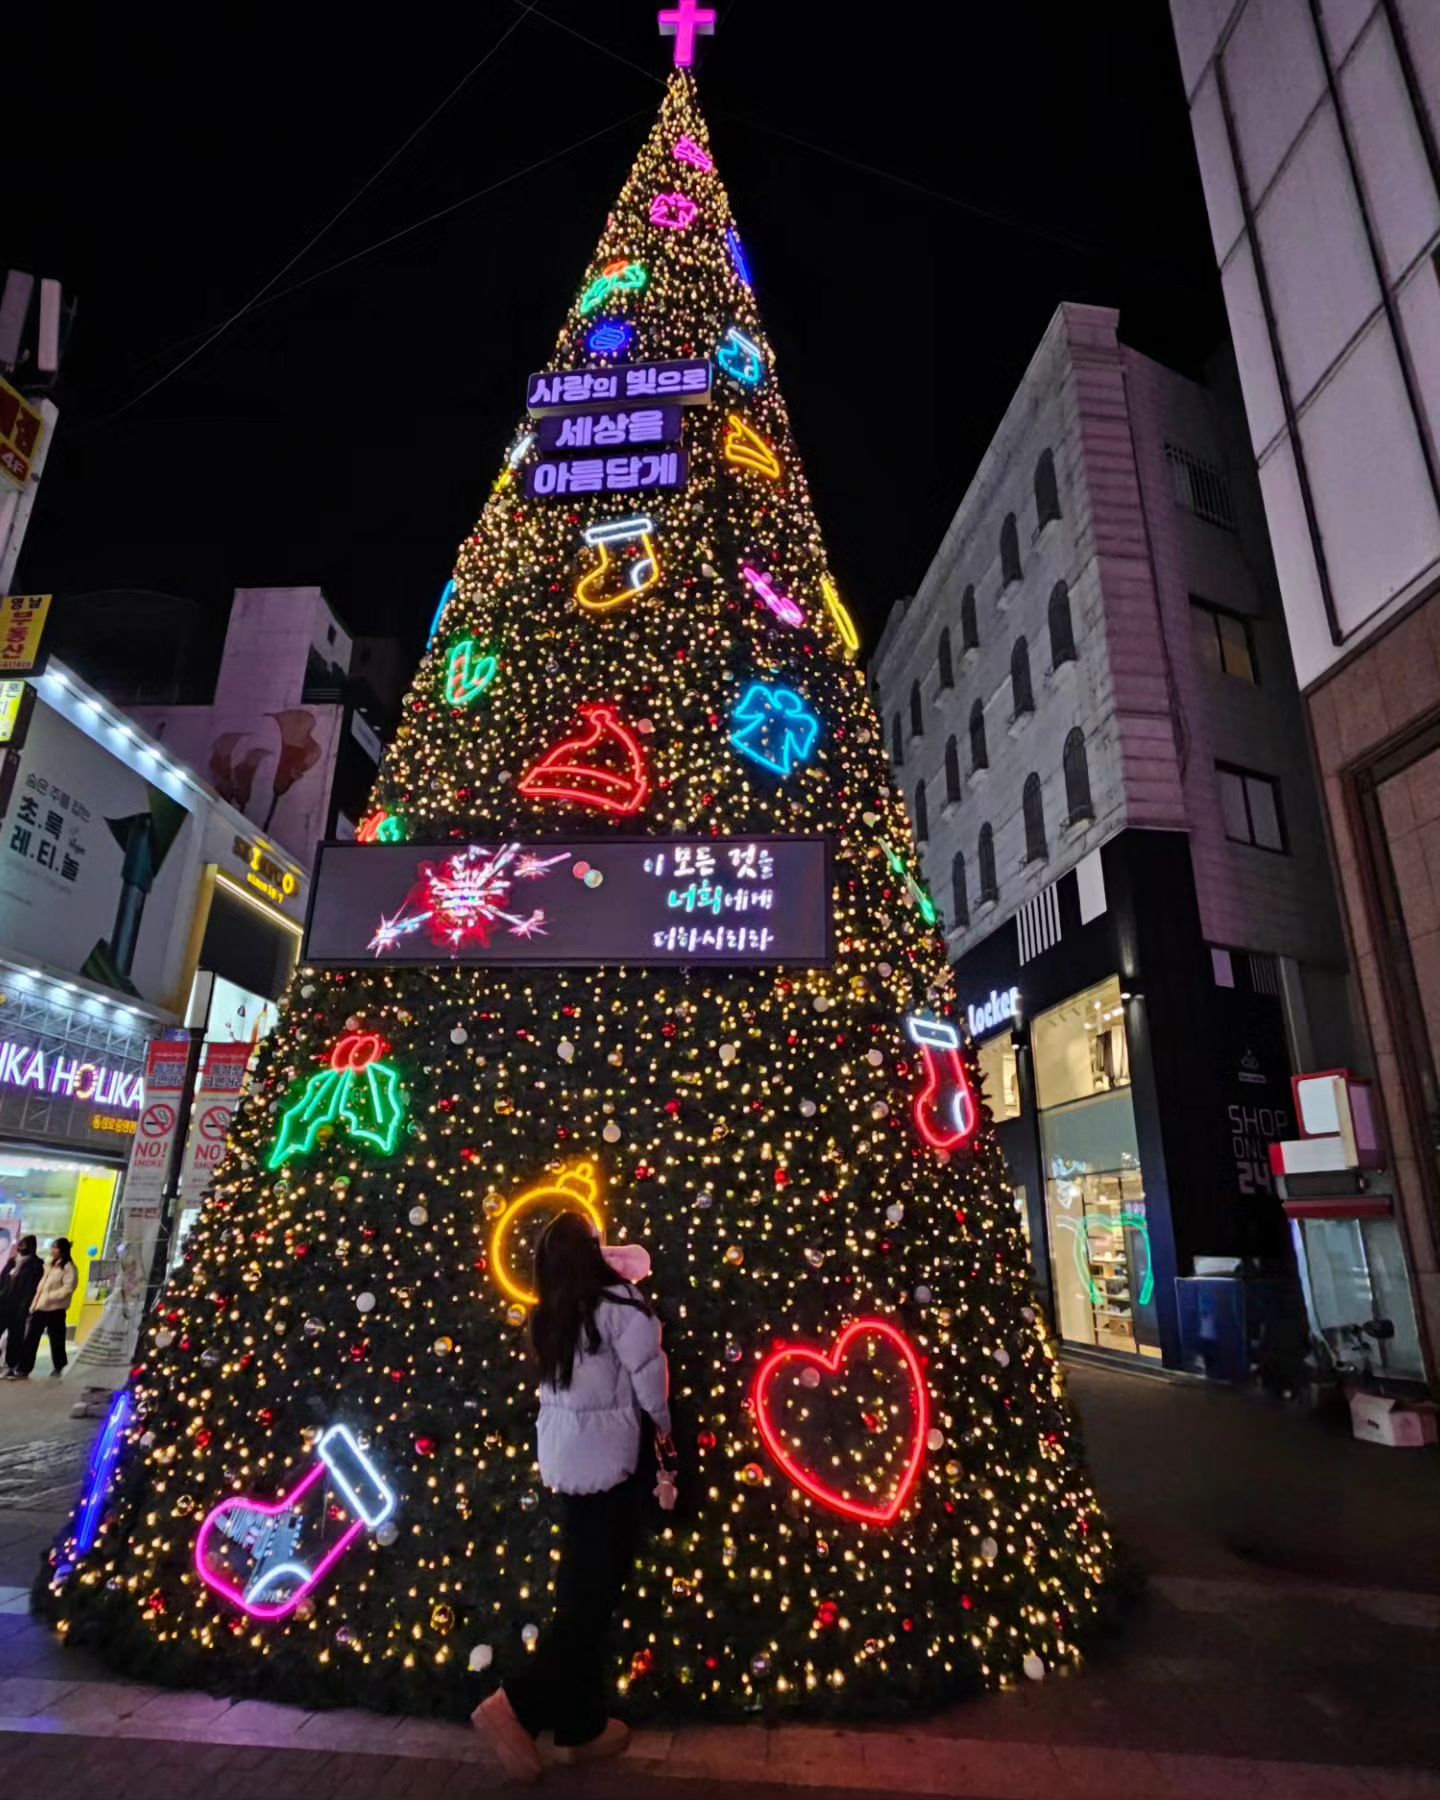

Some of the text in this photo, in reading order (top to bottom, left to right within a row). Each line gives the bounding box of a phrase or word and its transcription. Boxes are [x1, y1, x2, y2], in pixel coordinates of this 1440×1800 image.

[529, 368, 707, 404] 사랑의 빛으로
[555, 410, 664, 447] 세상을
[534, 453, 678, 493] 아름답게
[643, 844, 775, 880] 이 모든 것을
[667, 879, 773, 915] 너희에게
[653, 926, 775, 952] 더하시리라
[51, 1056, 144, 1109] HOLIKA
[1228, 1105, 1287, 1136] SHOP
[134, 1141, 168, 1159] NO!
[1237, 1161, 1271, 1195] 24
